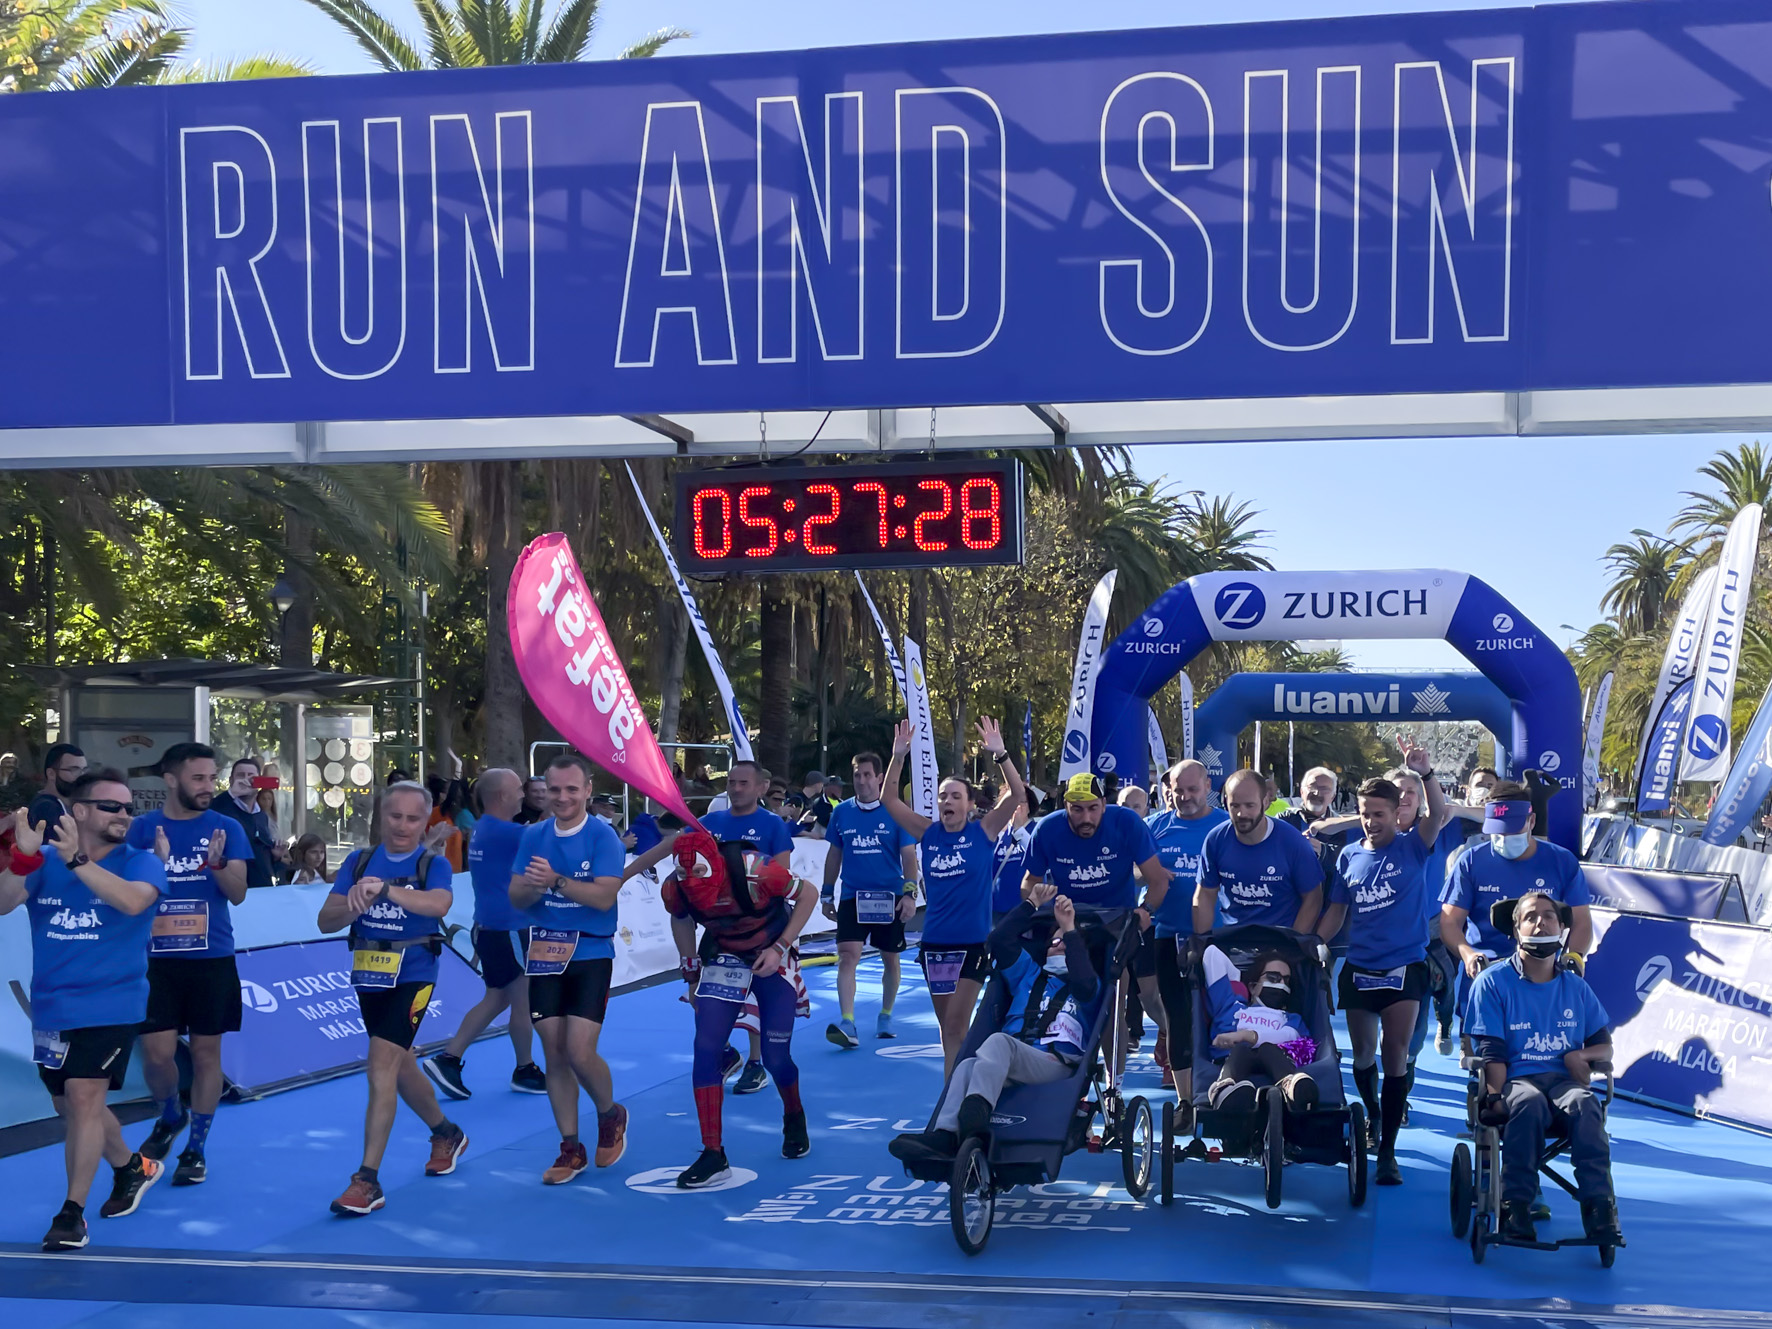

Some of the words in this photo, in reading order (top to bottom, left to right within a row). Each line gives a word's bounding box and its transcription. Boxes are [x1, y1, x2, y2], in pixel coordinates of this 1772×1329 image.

[180, 109, 536, 381] RUN
[615, 87, 1006, 369] AND
[1099, 57, 1516, 356] SUN
[693, 477, 1000, 558] 05:27:28
[1283, 589, 1427, 619] ZURICH
[537, 557, 635, 750] aefat
[1125, 642, 1181, 654] ZURICH
[1476, 637, 1533, 651] ZURICH
[1705, 569, 1740, 701] ZURICH
[1073, 625, 1101, 718] ZURICH
[917, 693, 929, 742] MINI
[1274, 683, 1400, 714] luanvi
[1646, 721, 1680, 800] luanvi
[370, 955, 391, 964] 1419
[546, 946, 567, 954] 2022
[319, 1019, 367, 1041] MÁLA
[1664, 1008, 1767, 1048] MARATÓN
[1651, 1039, 1737, 1079] MÁLAGA
